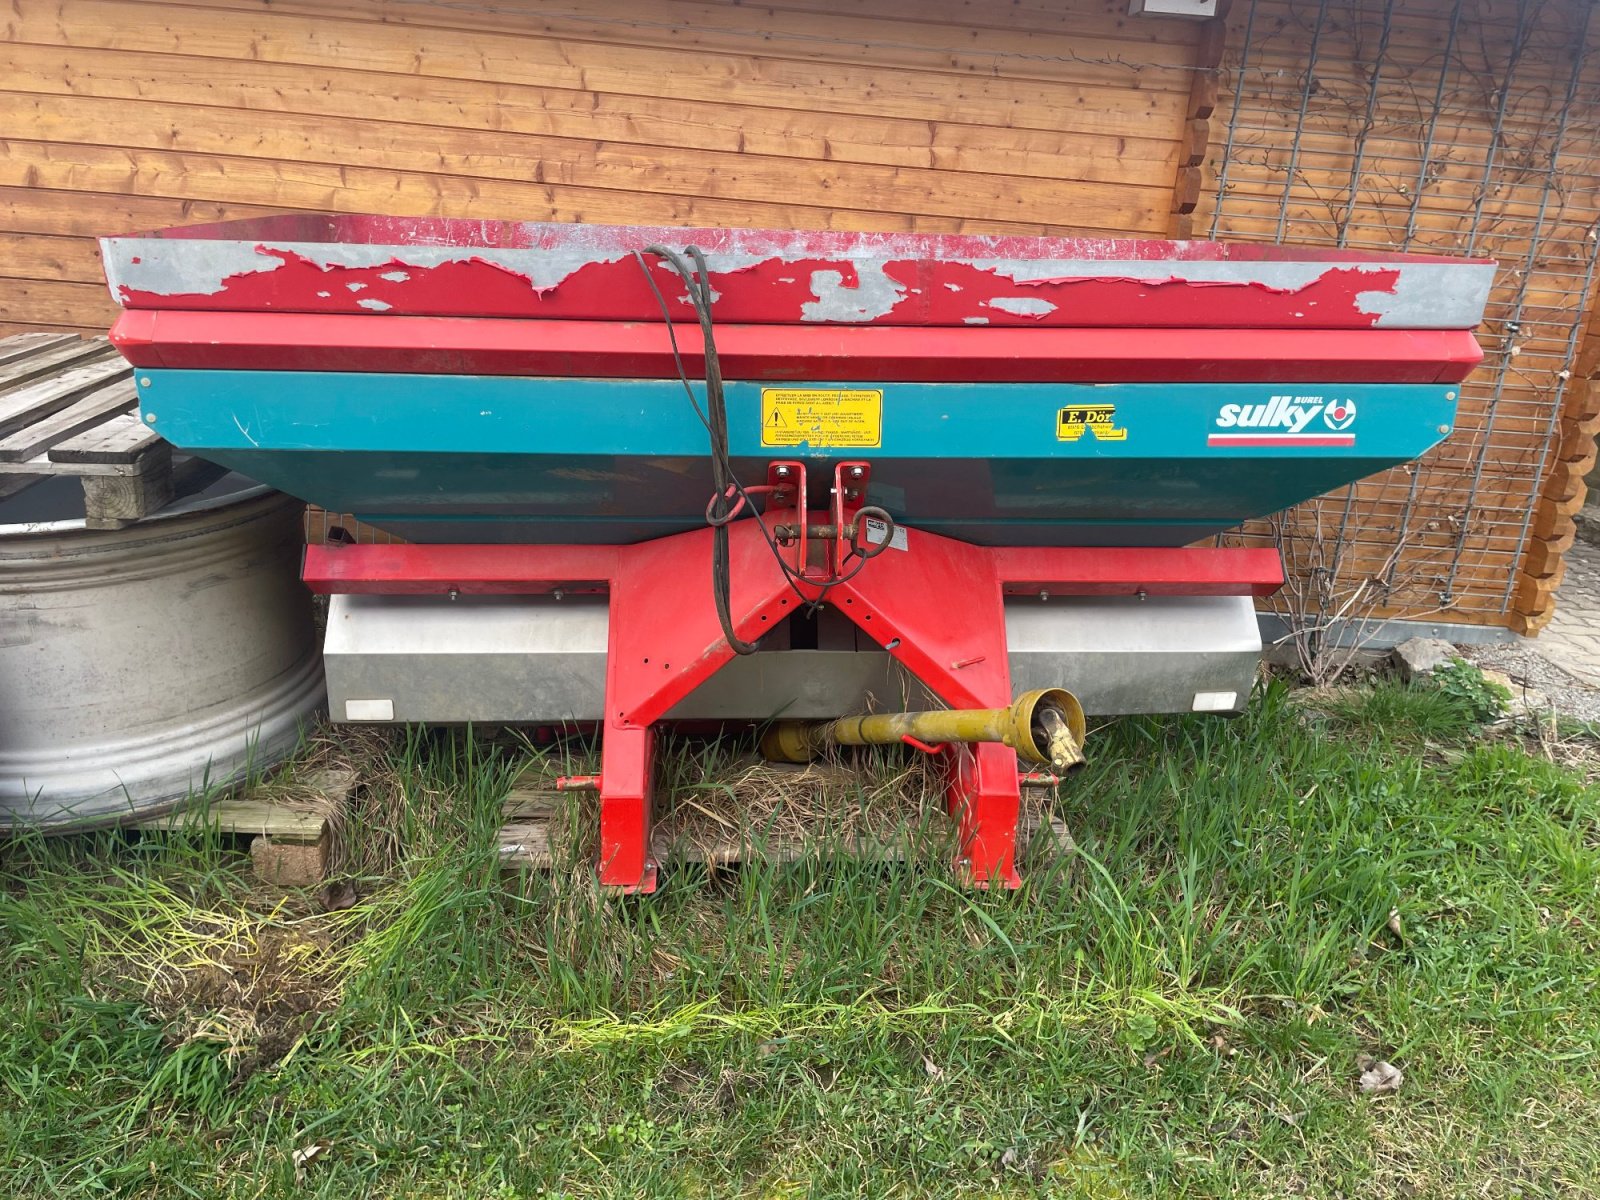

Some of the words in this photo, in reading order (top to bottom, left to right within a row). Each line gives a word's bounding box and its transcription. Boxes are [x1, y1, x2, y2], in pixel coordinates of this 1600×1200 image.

[1294, 396, 1324, 404] BUREL
[1067, 411, 1082, 423] E.
[1215, 395, 1324, 433] sulky
